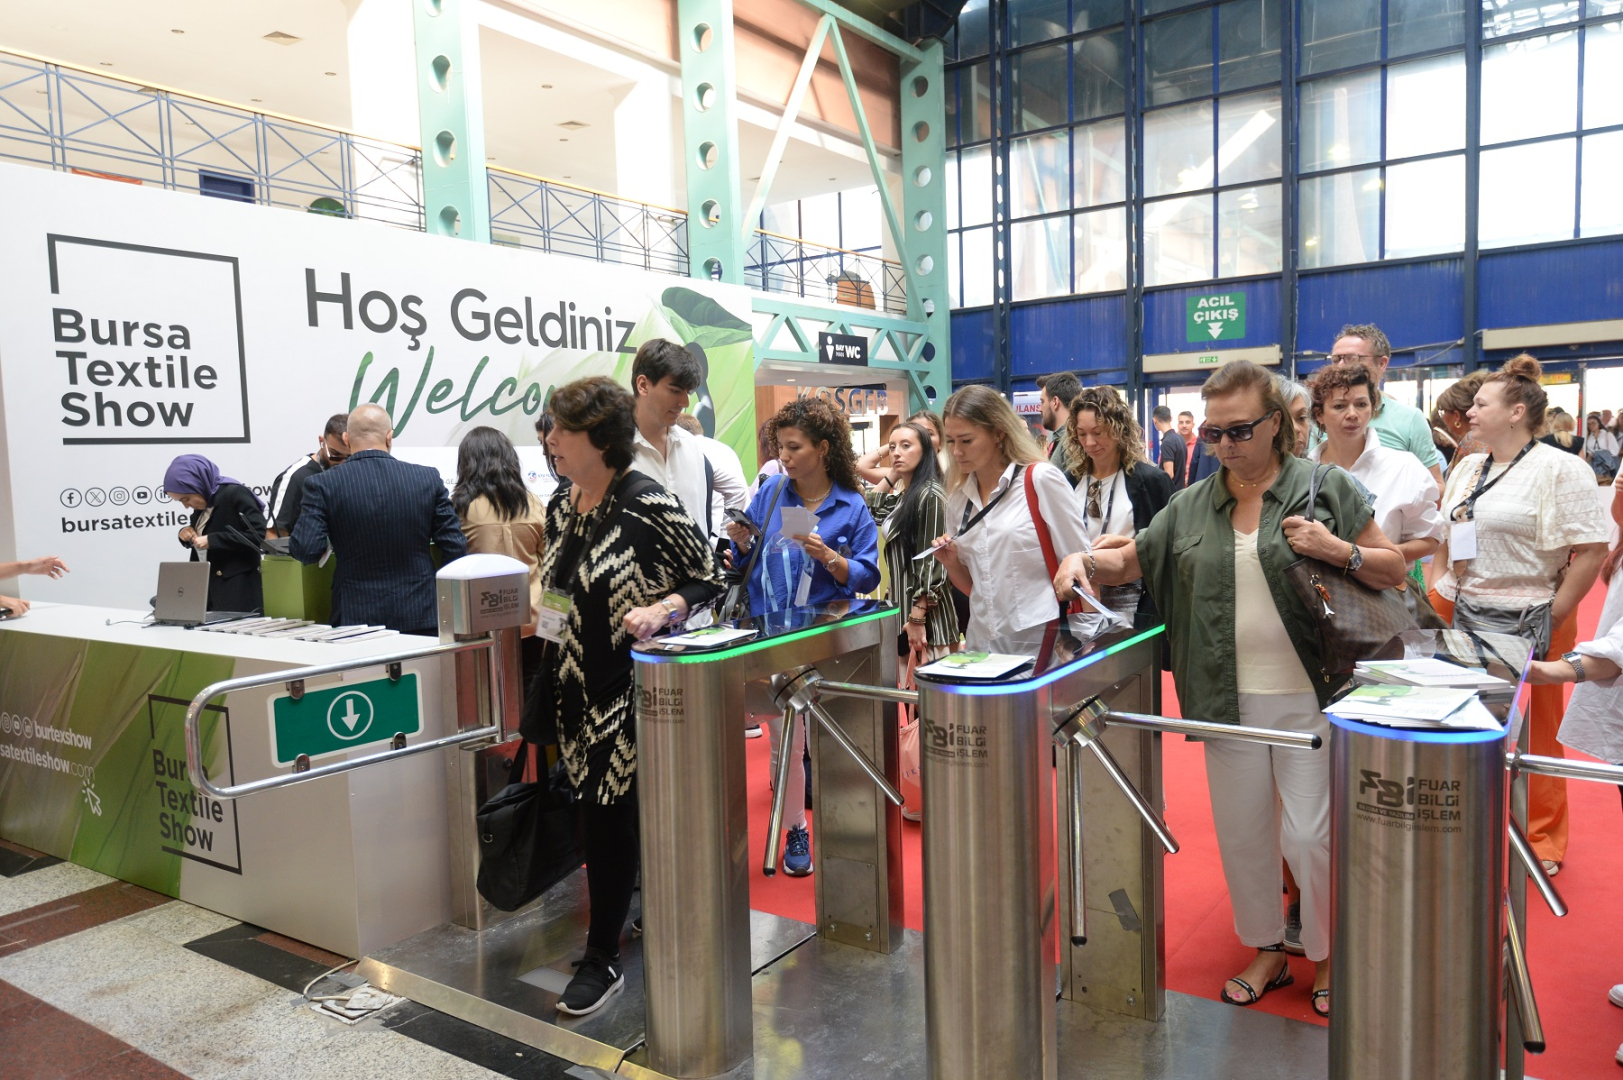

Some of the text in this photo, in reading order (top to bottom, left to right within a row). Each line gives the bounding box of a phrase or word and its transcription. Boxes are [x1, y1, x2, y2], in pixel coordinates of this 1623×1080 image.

[305, 268, 637, 354] Hoş Geldiniz
[1193, 308, 1239, 324] ÇIKIŞ
[52, 308, 191, 350] Bursa
[845, 345, 861, 359] WC
[55, 350, 218, 390] Textile
[349, 345, 555, 438] Welco
[60, 391, 195, 427] Show
[61, 511, 191, 533] bursatextile
[658, 688, 683, 696] FUAR
[34, 720, 92, 750] burtexshow
[956, 725, 987, 735] FUAR
[152, 748, 209, 782] Bura
[155, 780, 223, 823] Textile
[1418, 779, 1461, 791] FUAR
[159, 812, 213, 852] Show
